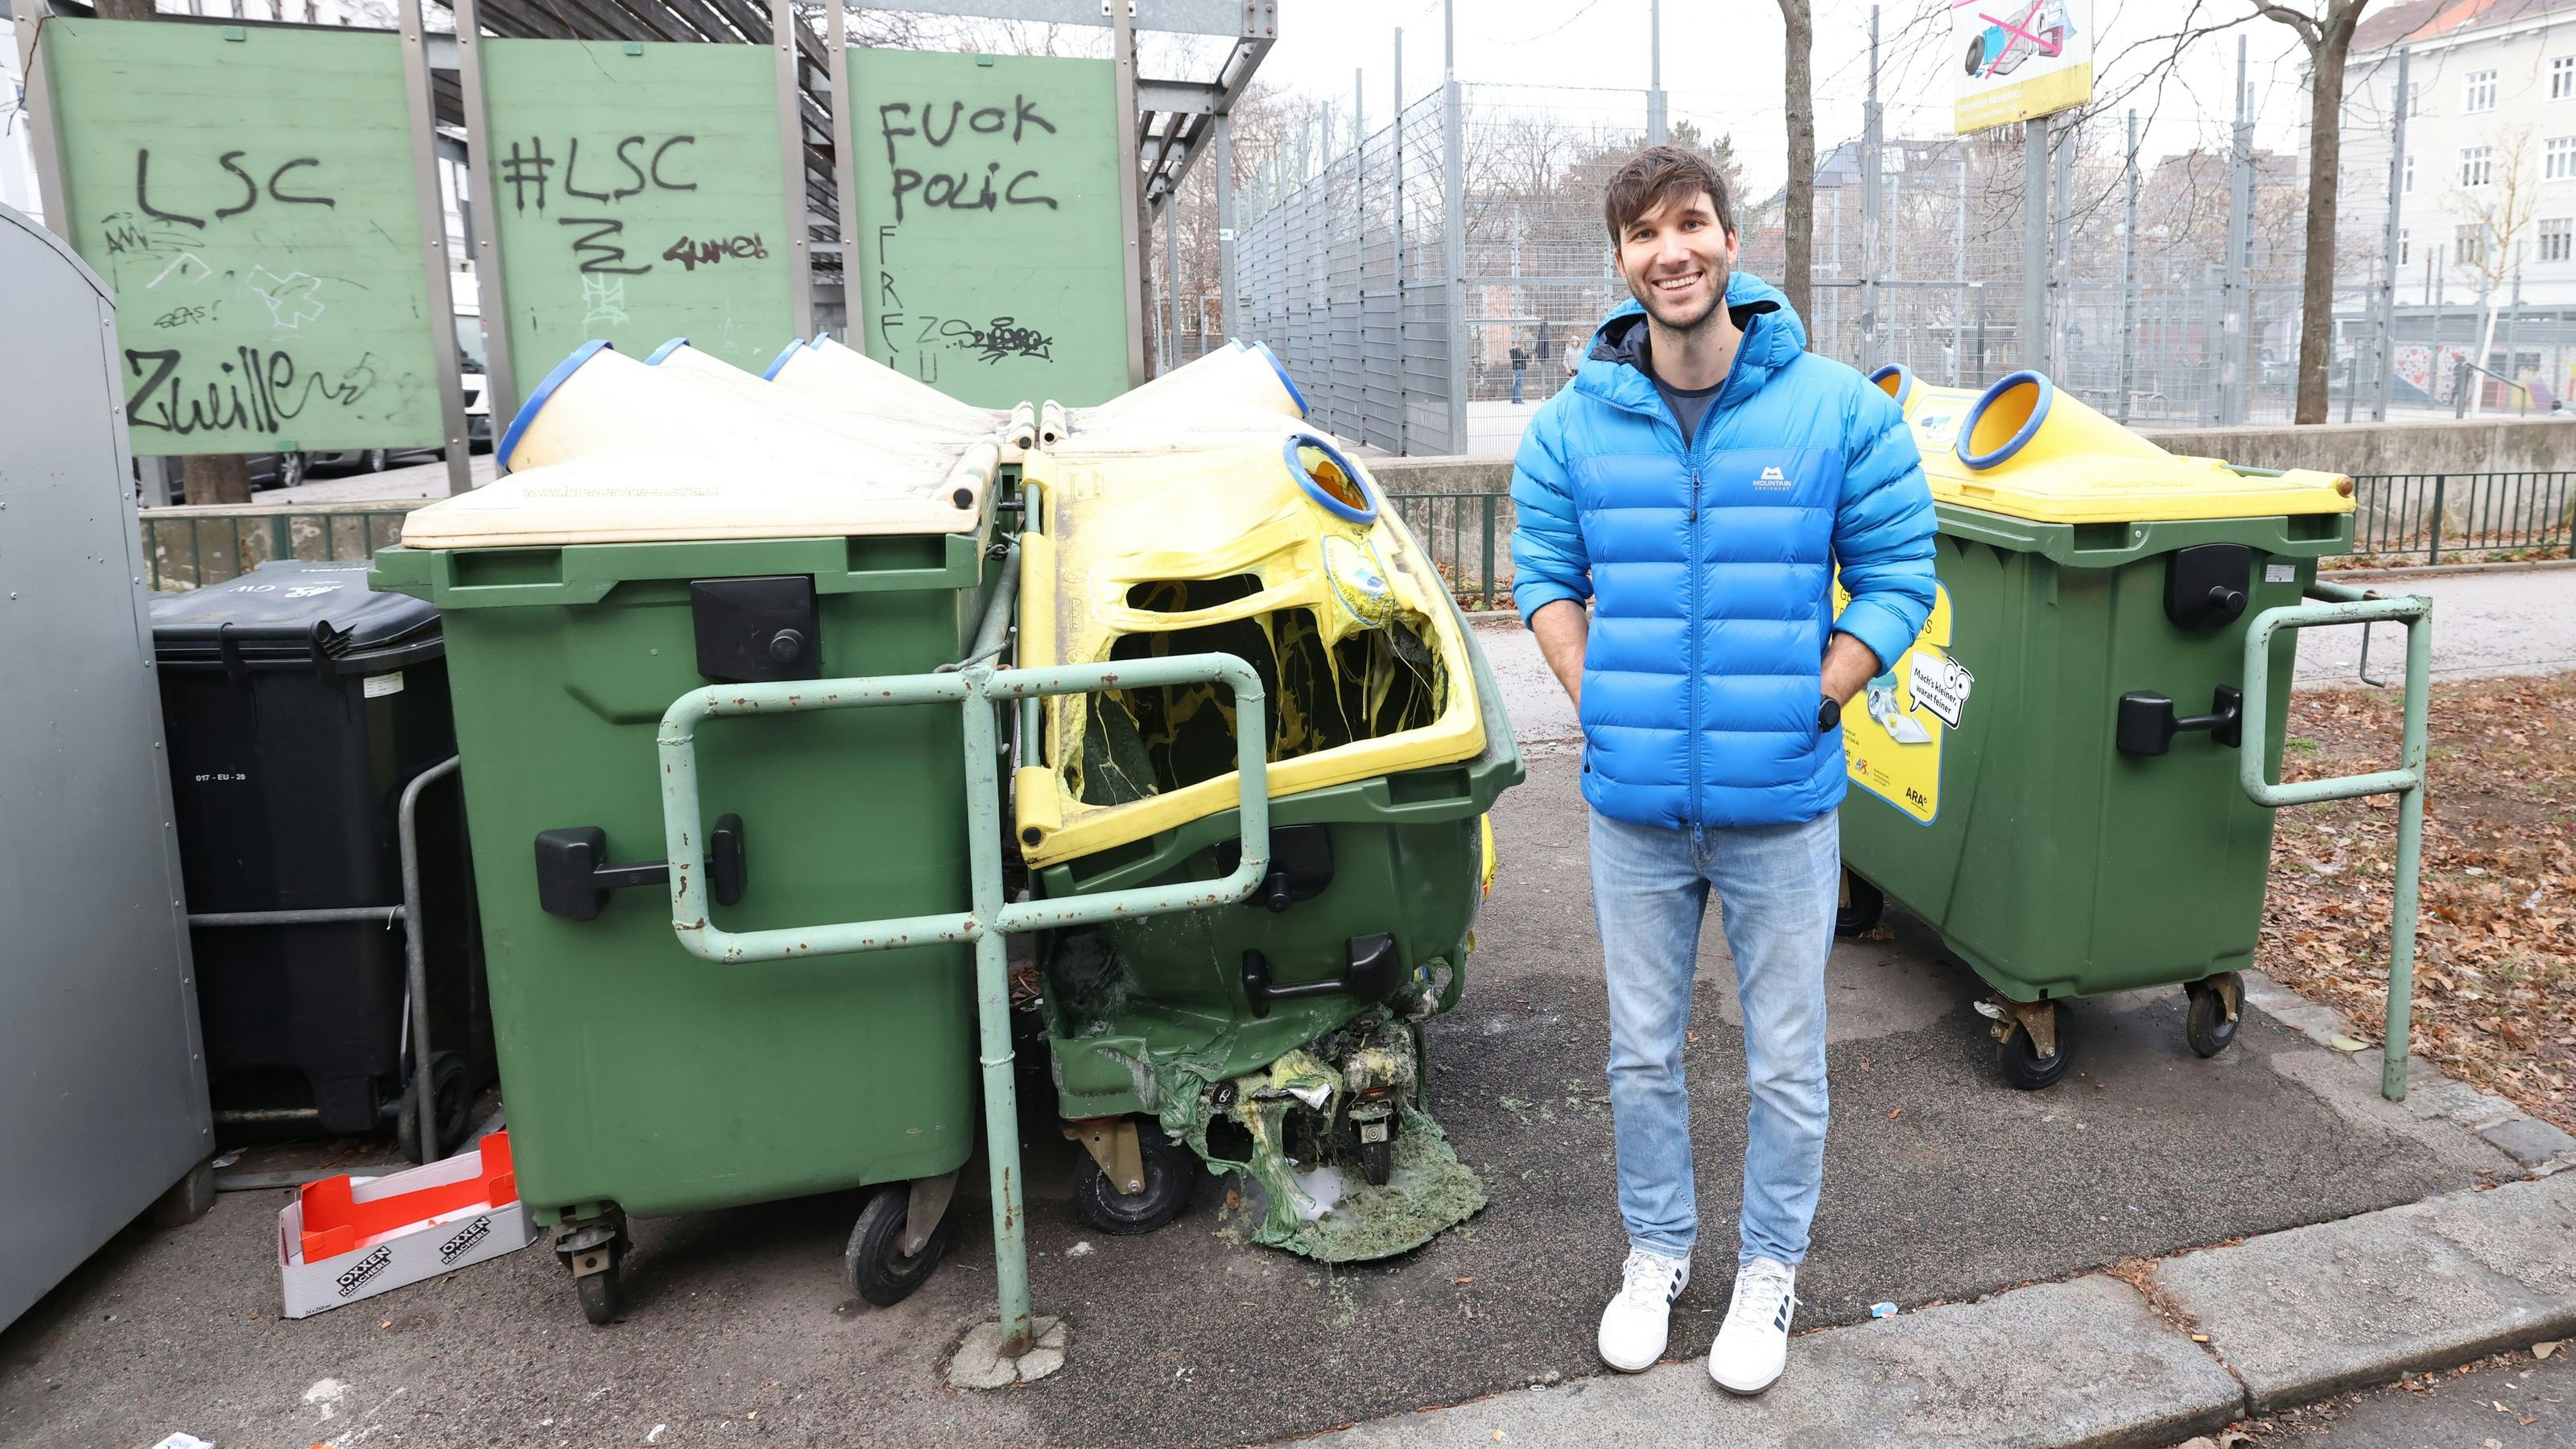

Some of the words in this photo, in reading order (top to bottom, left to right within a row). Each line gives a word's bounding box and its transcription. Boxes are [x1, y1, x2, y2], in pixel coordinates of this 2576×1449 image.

[137, 149, 335, 229] LSC
[502, 136, 698, 217] #LSC
[1914, 667, 1934, 688] Mach's
[1934, 681, 1957, 706] kleiner,
[1916, 684, 1934, 701] warat
[1934, 695, 1951, 714] feiner
[1906, 787, 1924, 807] ARA
[440, 1216, 490, 1254] OXXEN
[442, 1228, 489, 1265] KRACHERL
[339, 1247, 391, 1286] OXXEN
[339, 1259, 390, 1297] KRACHERL
[1752, 1259, 1776, 1272] didas
